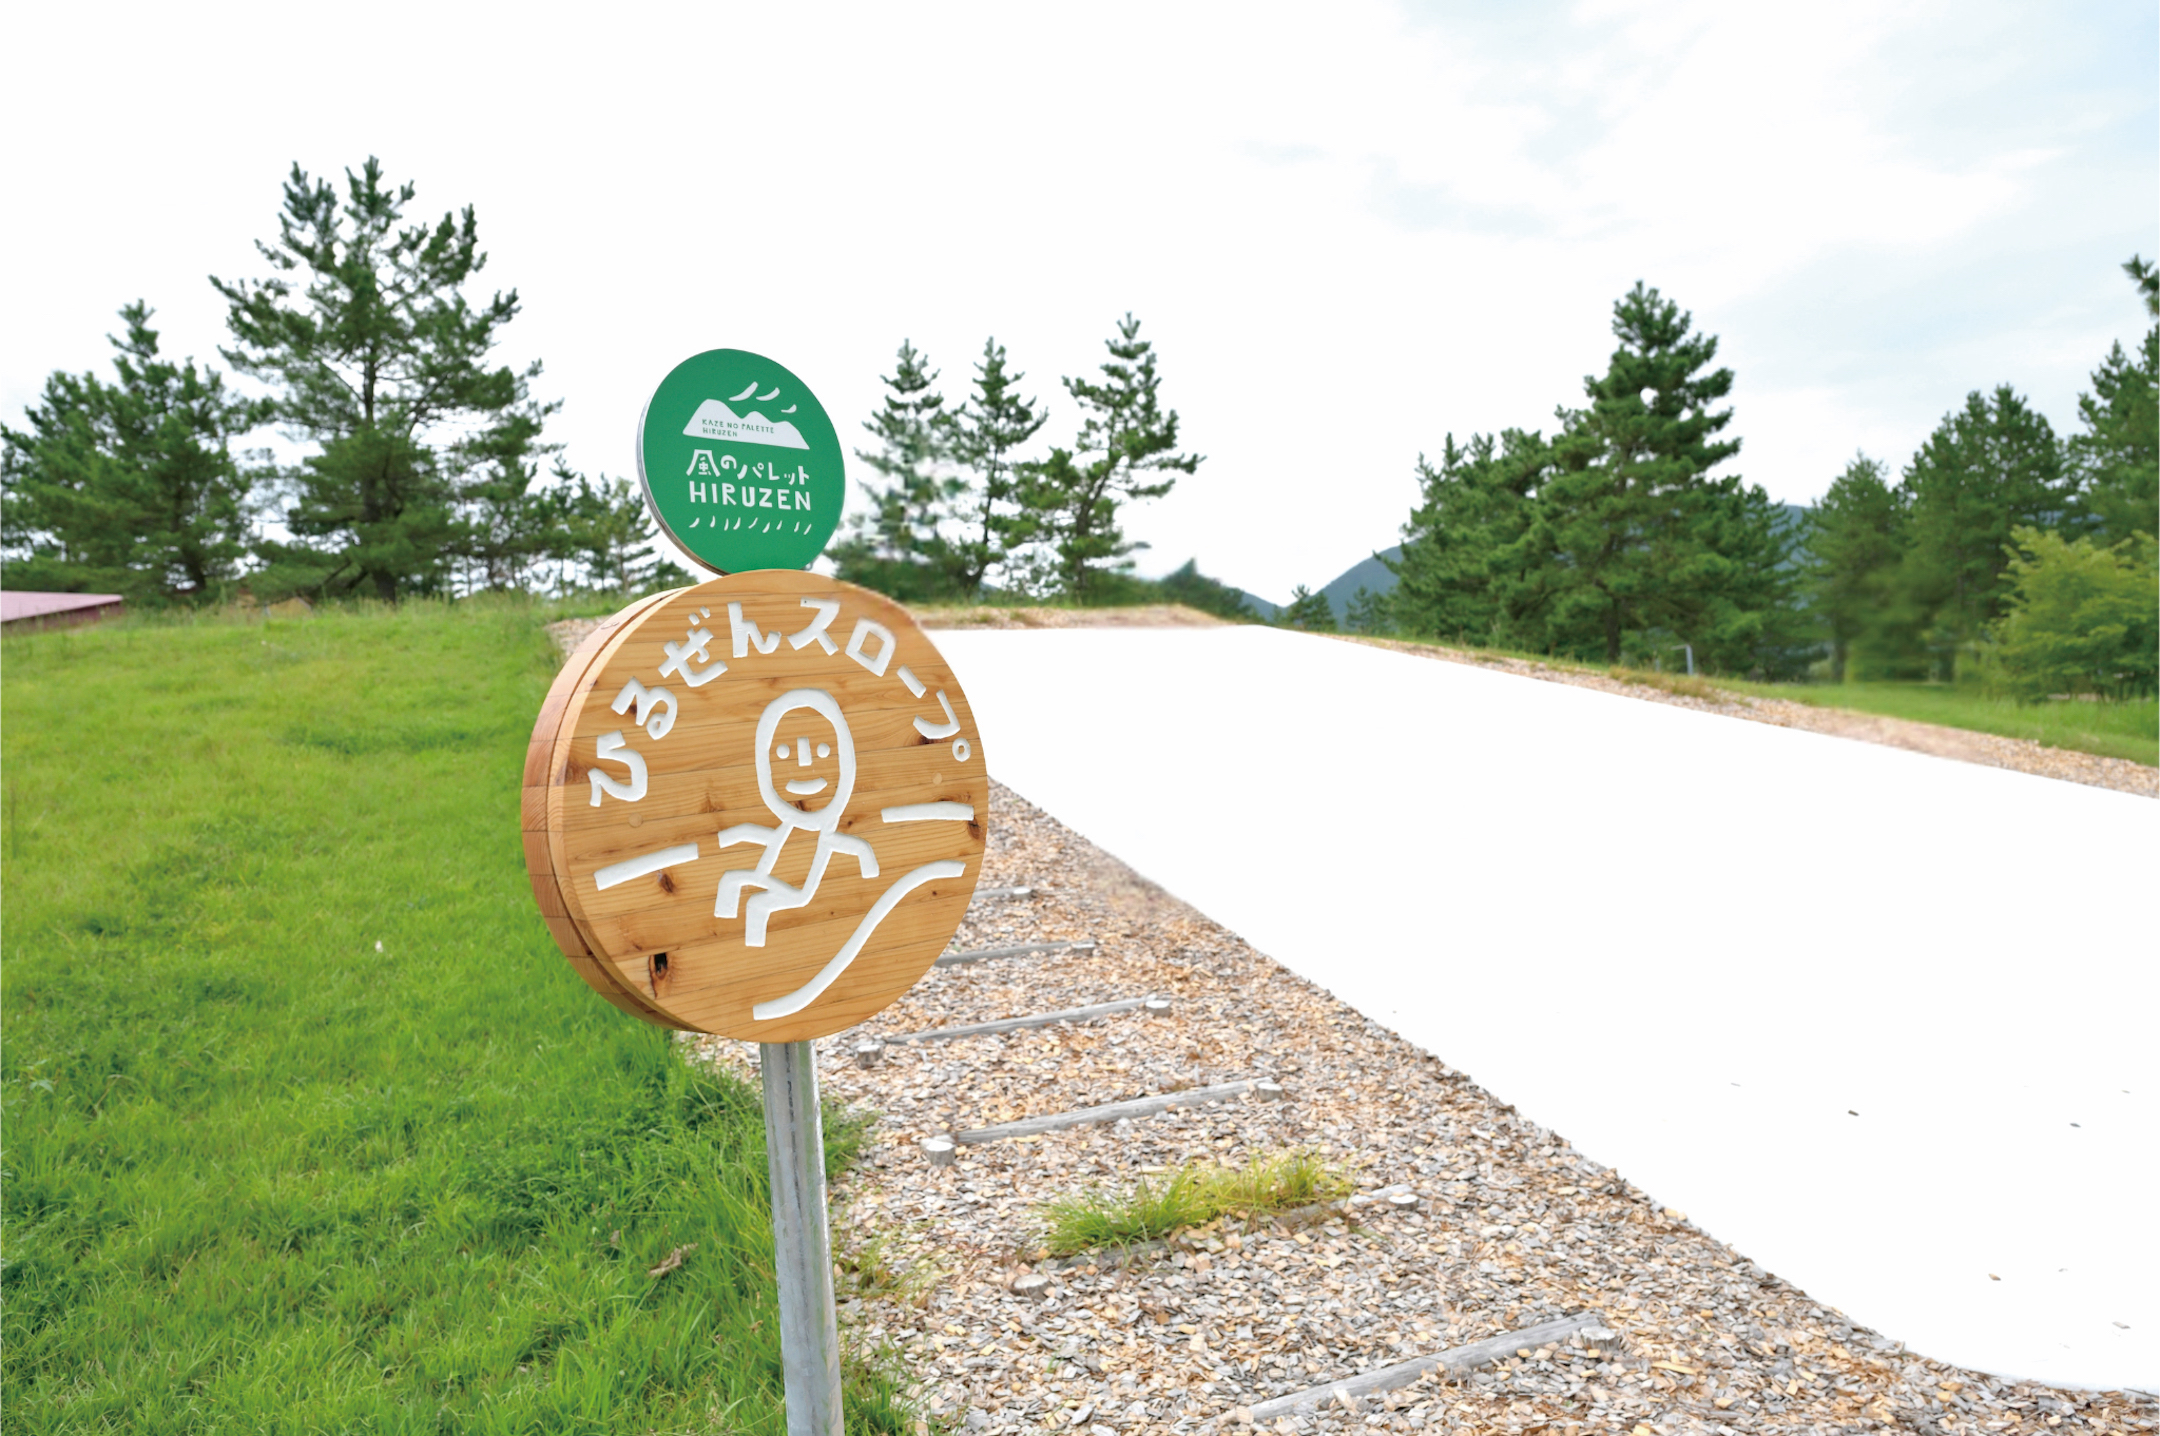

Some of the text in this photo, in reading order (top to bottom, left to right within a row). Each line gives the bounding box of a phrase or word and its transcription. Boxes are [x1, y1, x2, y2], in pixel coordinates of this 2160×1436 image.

[702, 418, 724, 427] KAZE
[742, 423, 774, 434] PALETTE
[702, 427, 738, 437] HIRUZEN
[686, 449, 810, 485] 風のパレット
[689, 480, 811, 511] HIRUZEN
